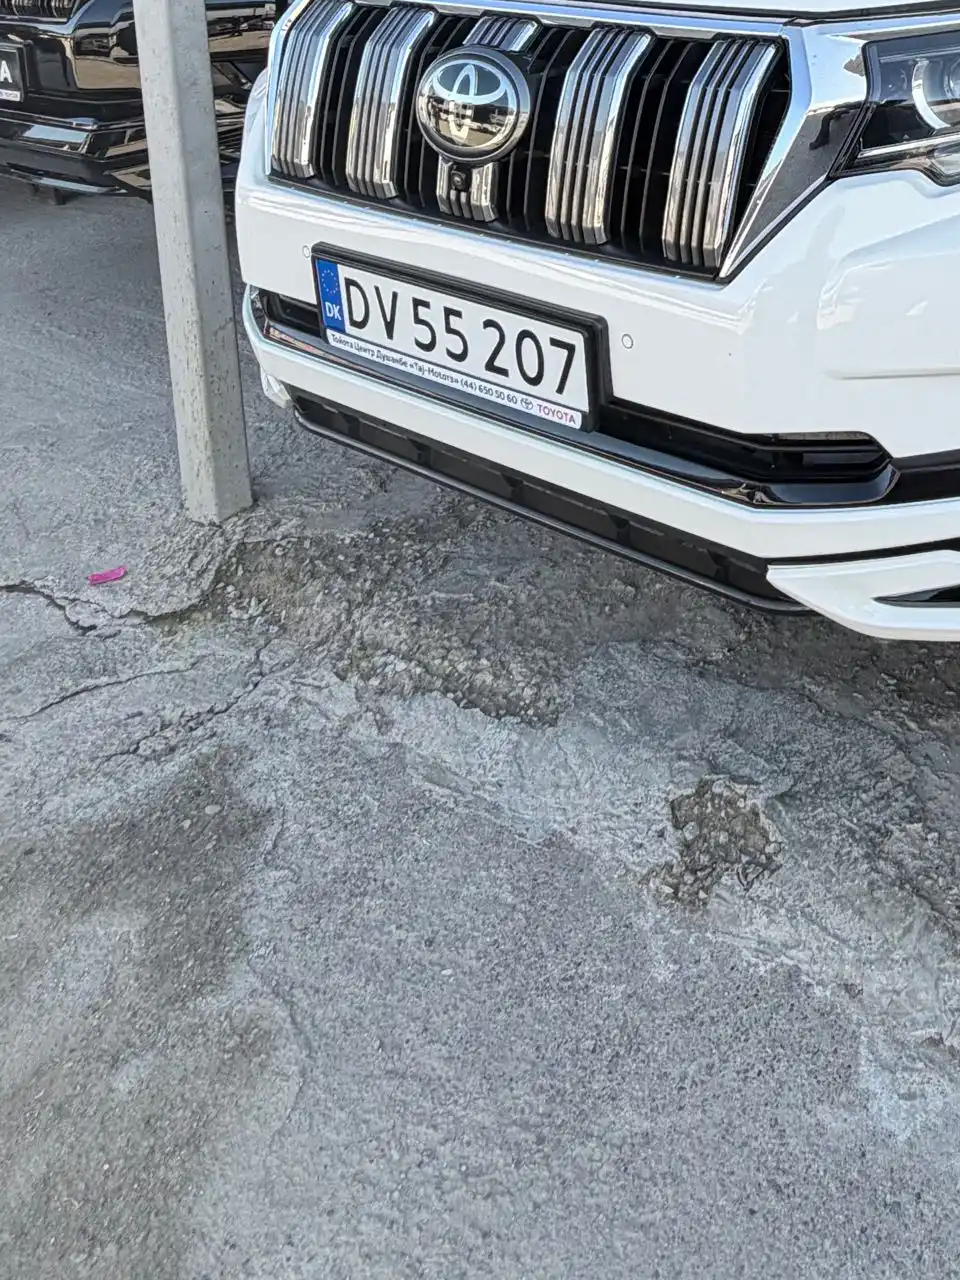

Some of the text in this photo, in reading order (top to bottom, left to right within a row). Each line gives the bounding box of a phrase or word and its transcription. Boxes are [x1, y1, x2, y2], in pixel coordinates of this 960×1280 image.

[325, 301, 342, 320] DK
[344, 276, 577, 395] DV 55 207
[460, 378, 478, 392] (44)
[478, 384, 494, 397] 650
[495, 390, 506, 401] 50
[506, 393, 518, 405] 60
[537, 402, 577, 425] TOYOTA
